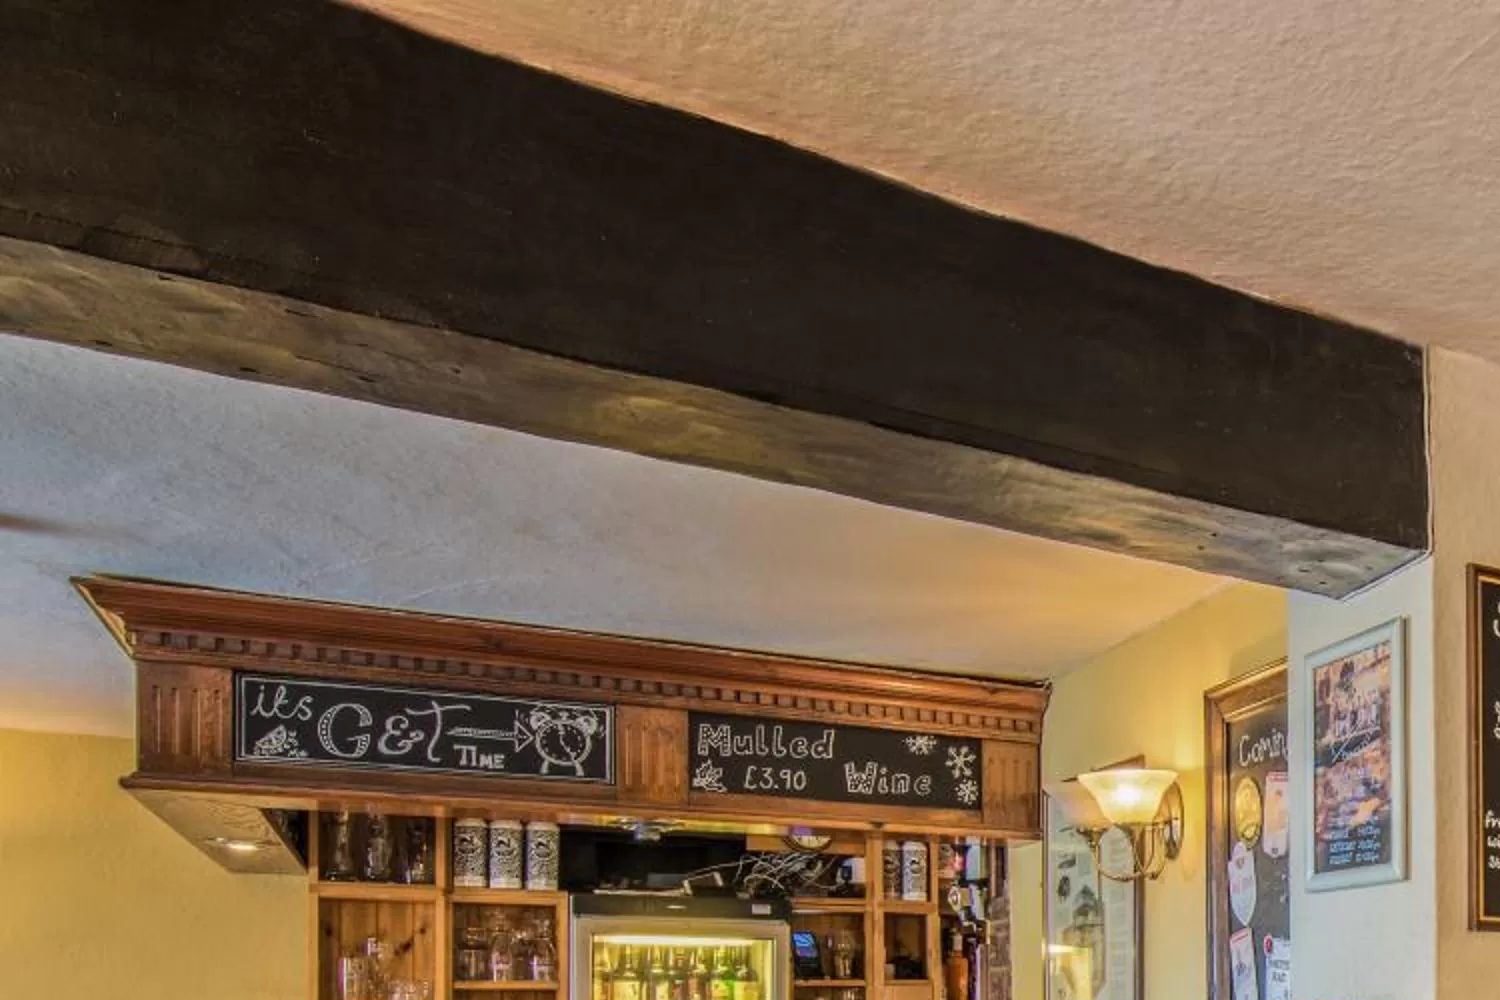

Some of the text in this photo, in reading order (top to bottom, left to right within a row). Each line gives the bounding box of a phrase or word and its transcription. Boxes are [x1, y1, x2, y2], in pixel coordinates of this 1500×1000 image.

[697, 723, 836, 759] Mulled
[743, 765, 807, 791] £3.90
[844, 761, 932, 796] Wine
